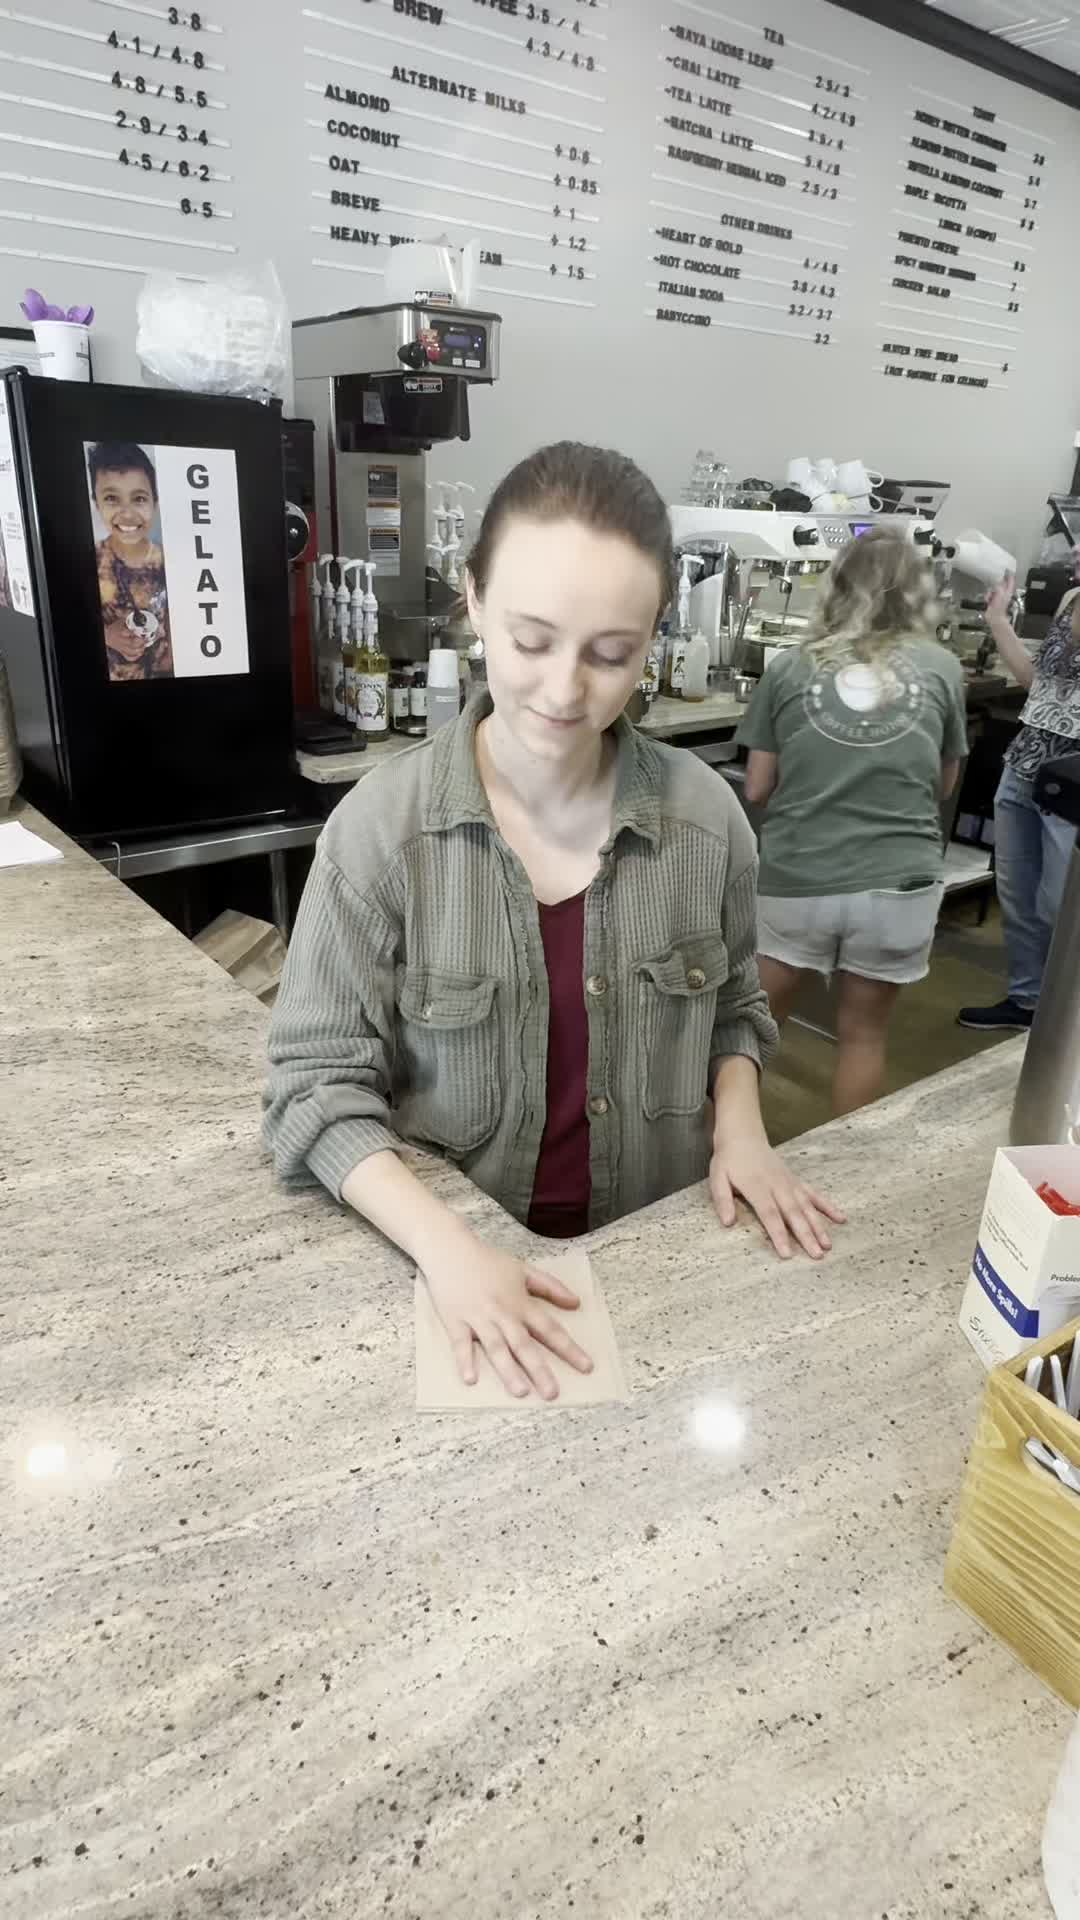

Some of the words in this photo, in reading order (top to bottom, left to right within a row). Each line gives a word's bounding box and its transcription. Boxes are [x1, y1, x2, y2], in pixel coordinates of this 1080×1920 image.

[168, 7, 201, 31] 3.8
[392, 0, 443, 26] BREW
[763, 27, 785, 46] TEA
[107, 30, 141, 54] 4.1
[171, 46, 204, 69] 4.8
[111, 71, 146, 94] 4.8
[174, 85, 207, 108] 5.5
[706, 68, 741, 89] LATTE
[324, 84, 391, 113] ALMOND
[390, 66, 477, 102] ALTERNATE
[485, 91, 527, 115] MILKS
[698, 95, 733, 116] LATTE
[115, 110, 151, 134] 2.9
[177, 125, 209, 146] 3.4
[326, 119, 401, 148] COCONUT
[720, 130, 754, 152] LATTE
[118, 148, 152, 171] 4.5
[328, 155, 360, 174] OAT
[330, 190, 381, 212] BREVE
[330, 226, 380, 246] HEAVY
[720, 213, 755, 233] OTHER
[757, 221, 792, 240] DRINKS
[699, 235, 713, 249] OF
[715, 238, 744, 255] GOLD
[684, 257, 741, 279] CHOCOLATE
[658, 281, 697, 299] ITALIAN
[699, 287, 724, 303] SODA
[186, 464, 222, 658] GELATO
